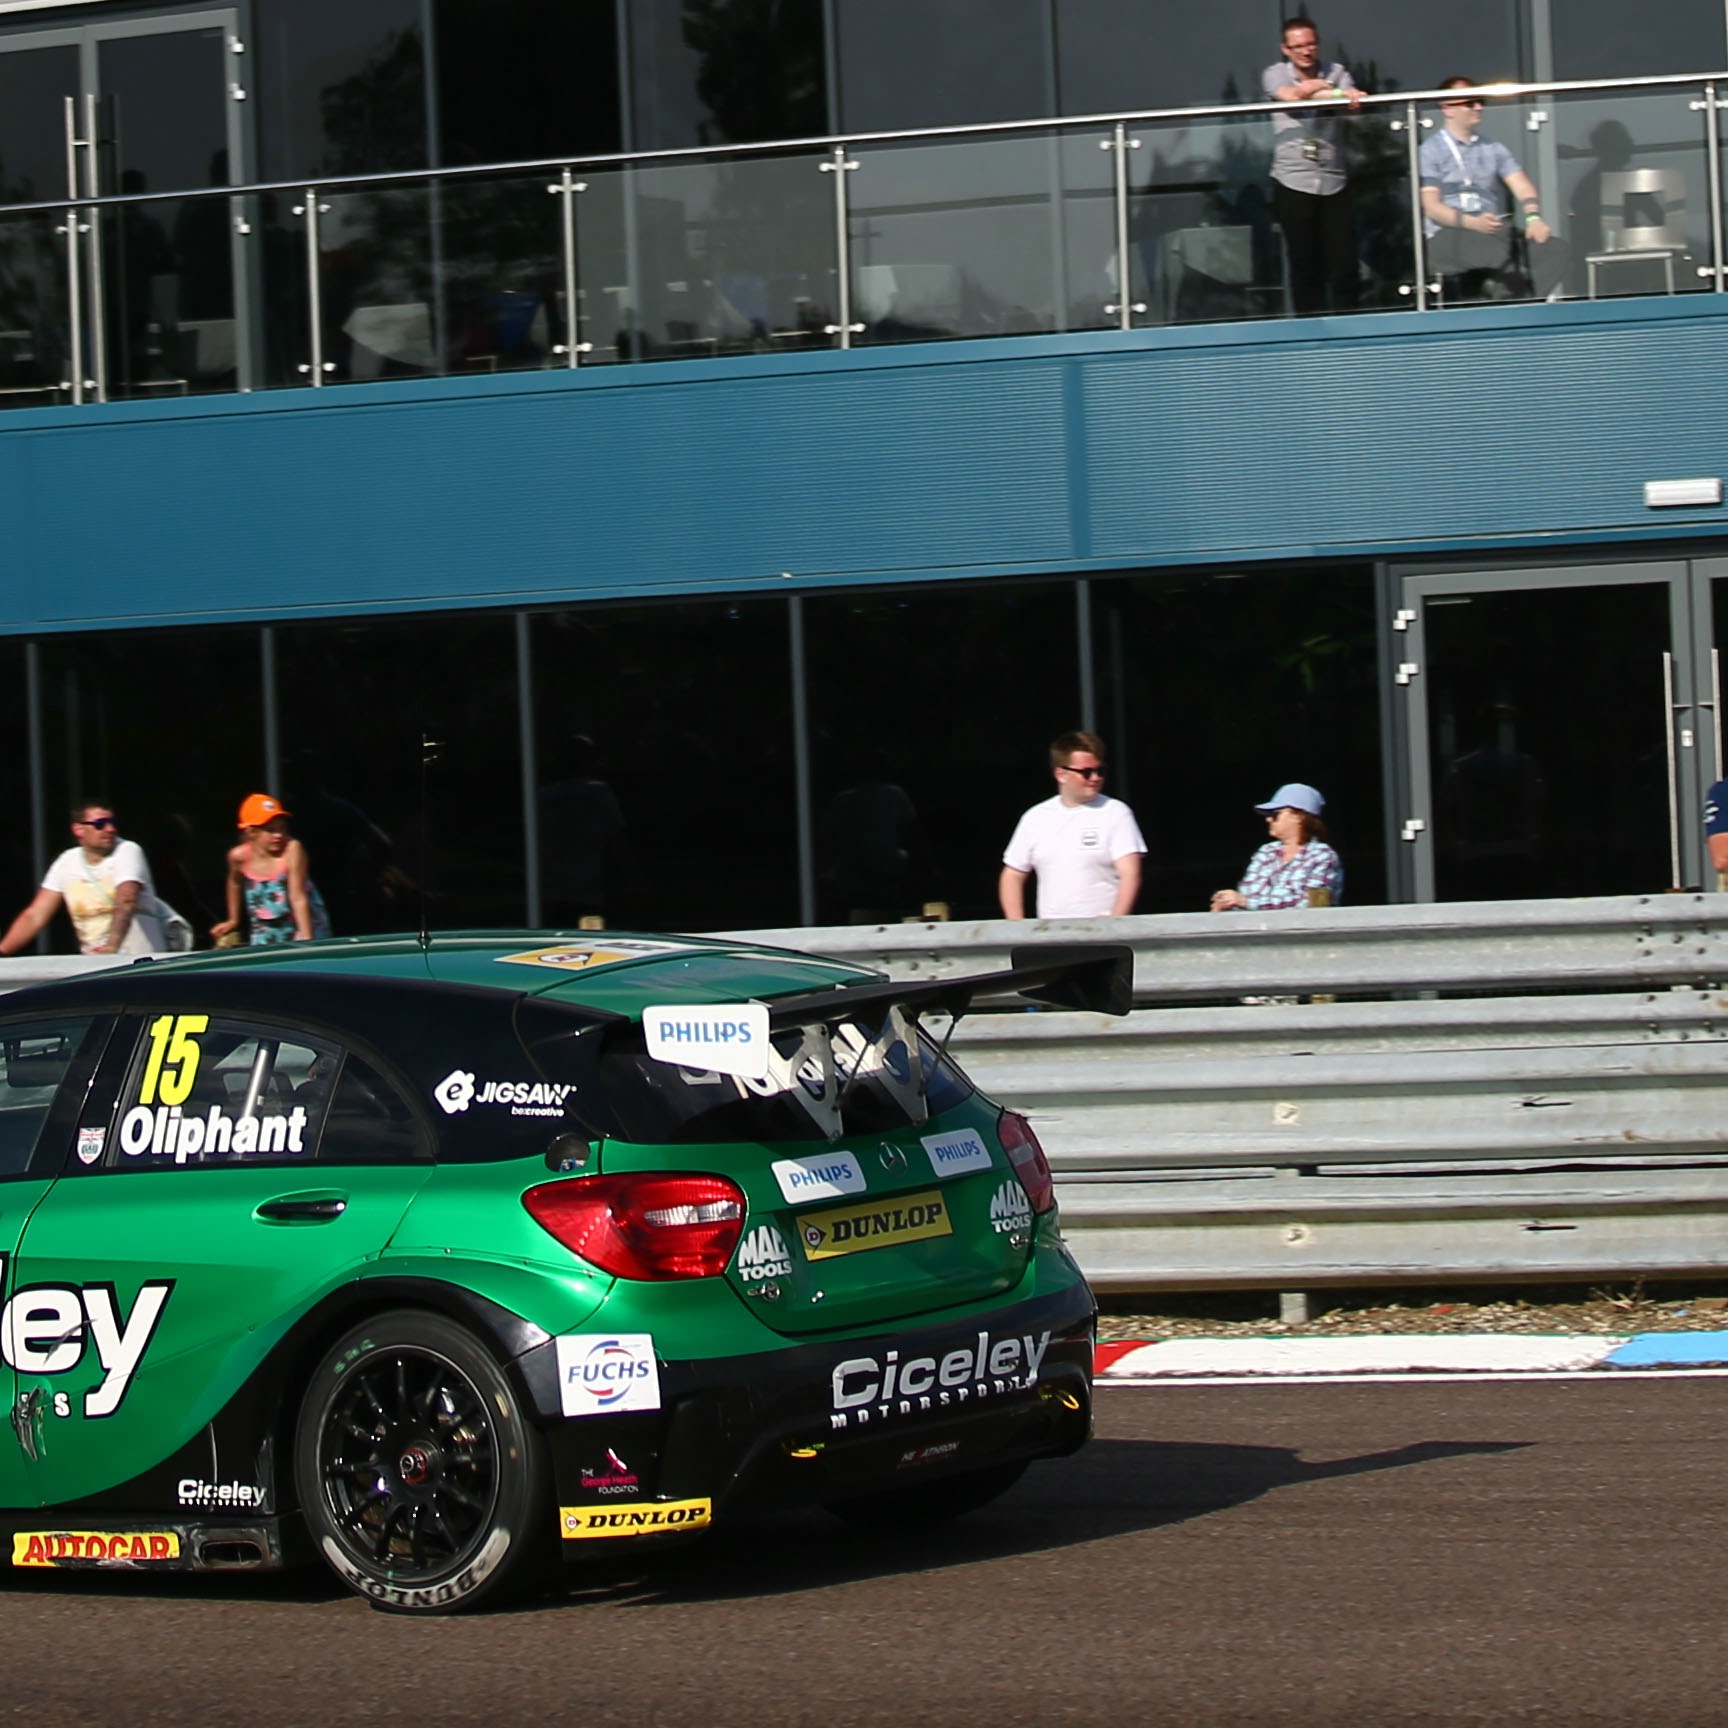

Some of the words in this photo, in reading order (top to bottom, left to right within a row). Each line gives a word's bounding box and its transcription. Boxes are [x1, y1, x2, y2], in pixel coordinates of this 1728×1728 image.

[660, 1022, 752, 1044] PHILIPS
[139, 1015, 209, 1106] 15
[121, 1105, 307, 1164] Oliphant
[934, 1140, 981, 1163] PHILIPS
[789, 1164, 853, 1189] PHILIPS
[831, 1202, 943, 1244] DUNLOP
[990, 1214, 1032, 1233] TOOLS
[738, 1225, 790, 1268] MAC
[739, 1259, 793, 1282] TOOLS
[567, 1359, 650, 1384] FUCHS
[832, 1330, 1052, 1409] Ciceley
[178, 1479, 267, 1507] Ciceley
[586, 1507, 706, 1529] DUNLOP
[22, 1535, 170, 1563] AUTOCAR
